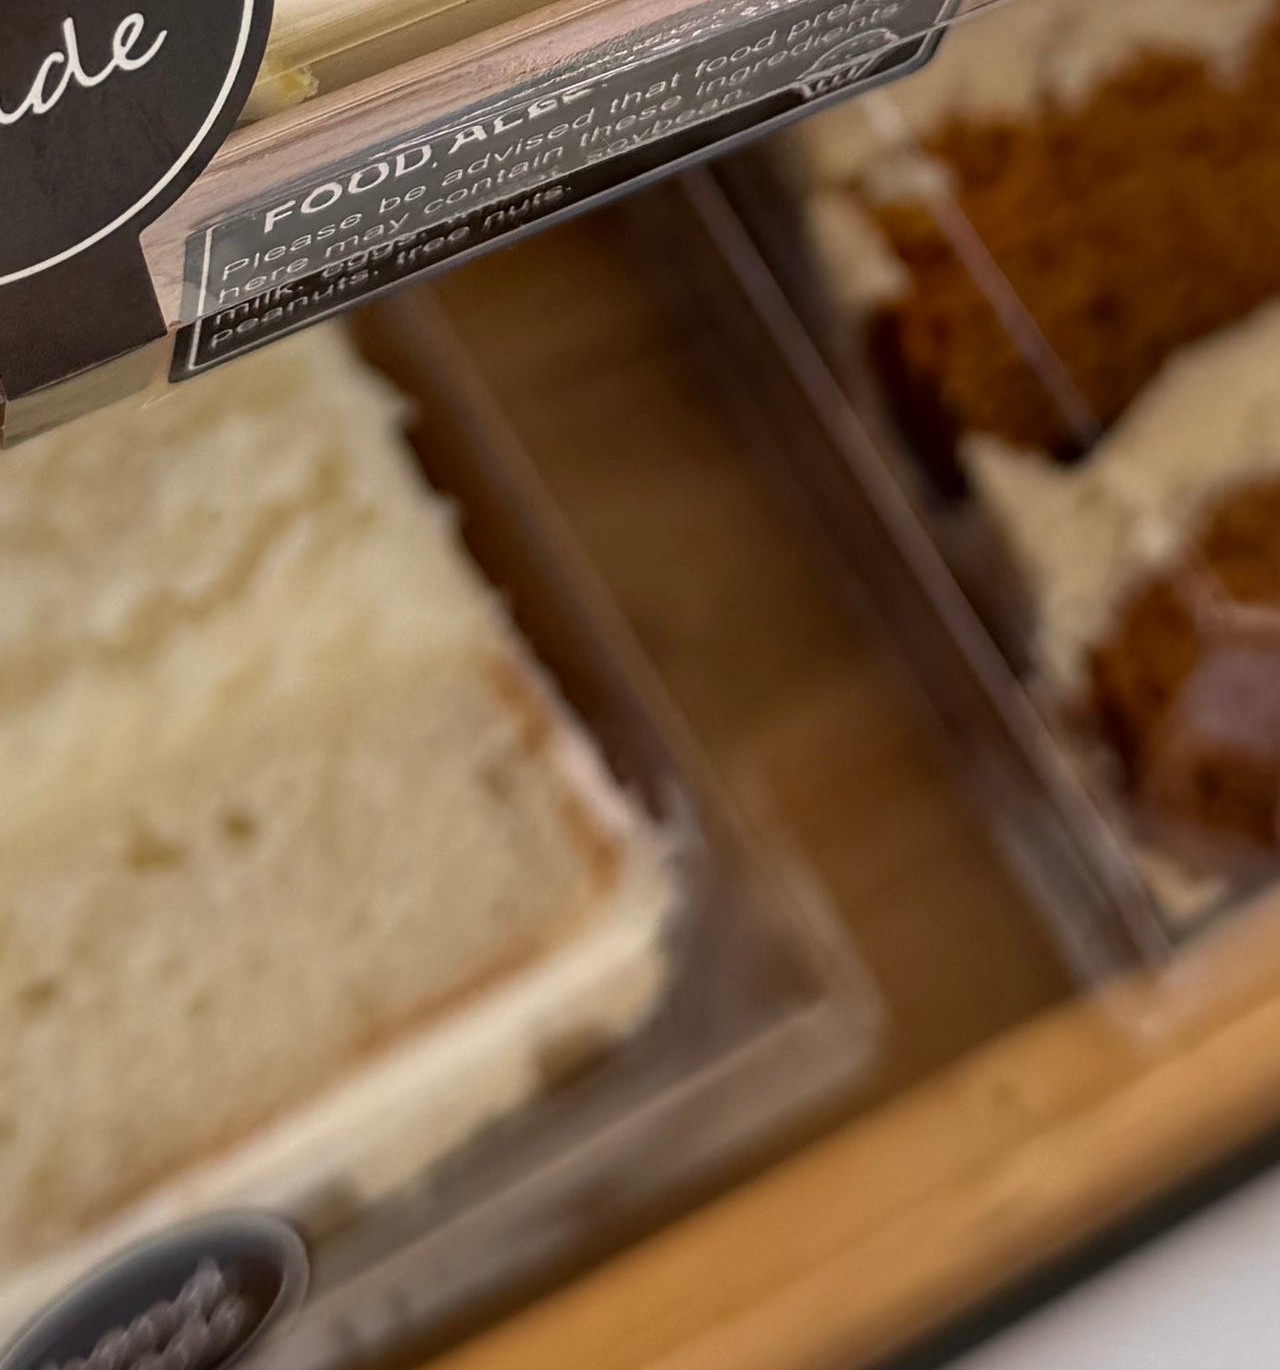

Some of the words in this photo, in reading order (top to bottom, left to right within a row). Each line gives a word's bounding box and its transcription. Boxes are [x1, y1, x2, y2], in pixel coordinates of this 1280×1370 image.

[218, 256, 310, 305] here
[324, 211, 410, 260] may
[423, 145, 565, 216] contain
[578, 93, 683, 148] these
[221, 212, 363, 281] Please
[379, 183, 428, 215] be
[440, 106, 596, 187] advised
[610, 71, 681, 115] that
[694, 28, 778, 79] food
[262, 143, 432, 234] FOOD
